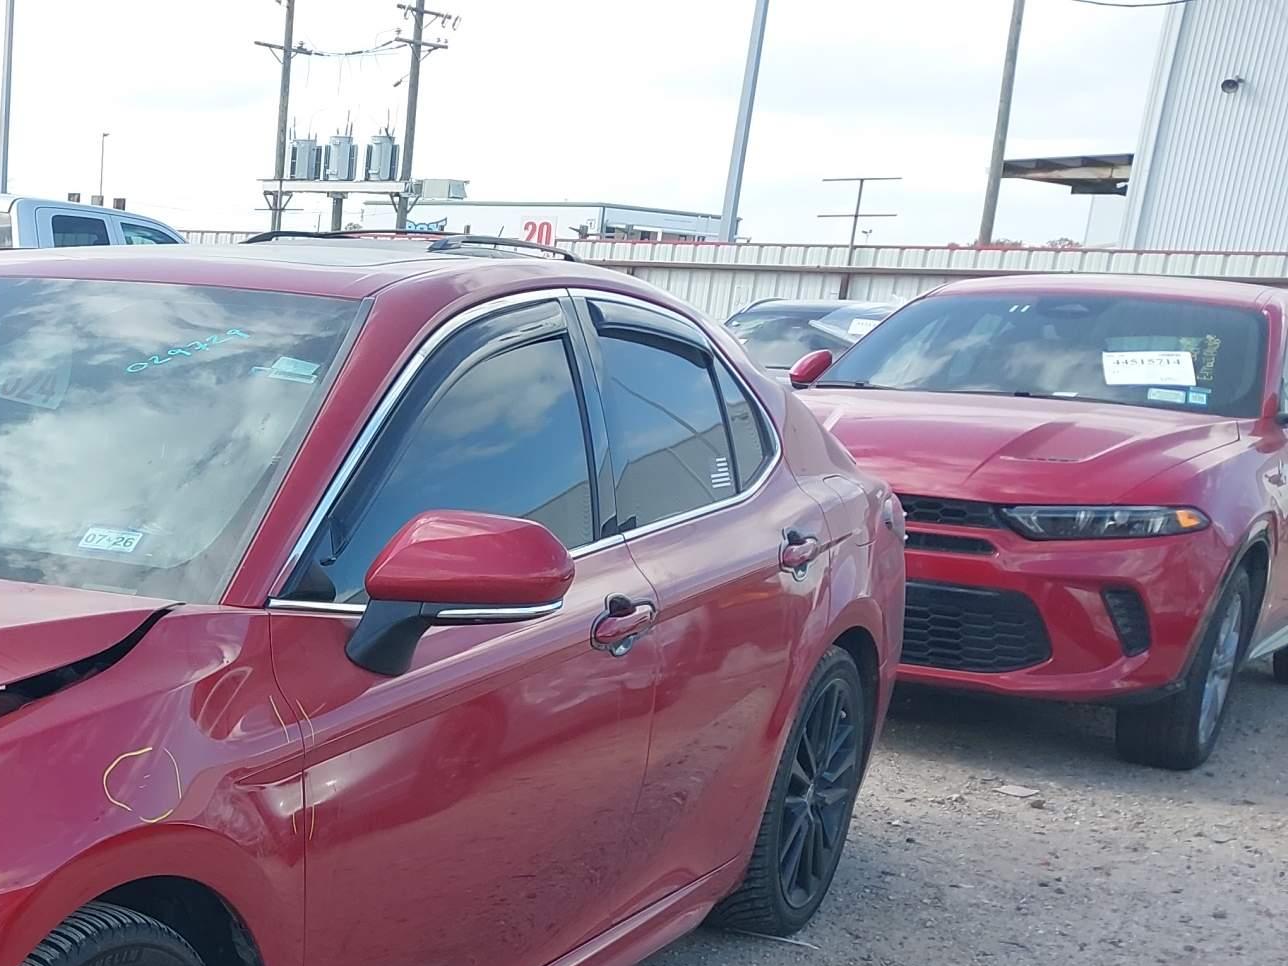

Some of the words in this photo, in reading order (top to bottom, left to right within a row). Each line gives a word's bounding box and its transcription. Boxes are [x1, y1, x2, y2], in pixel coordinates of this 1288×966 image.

[523, 221, 553, 247] 20
[84, 533, 108, 545] 07
[112, 536, 134, 548] 26
